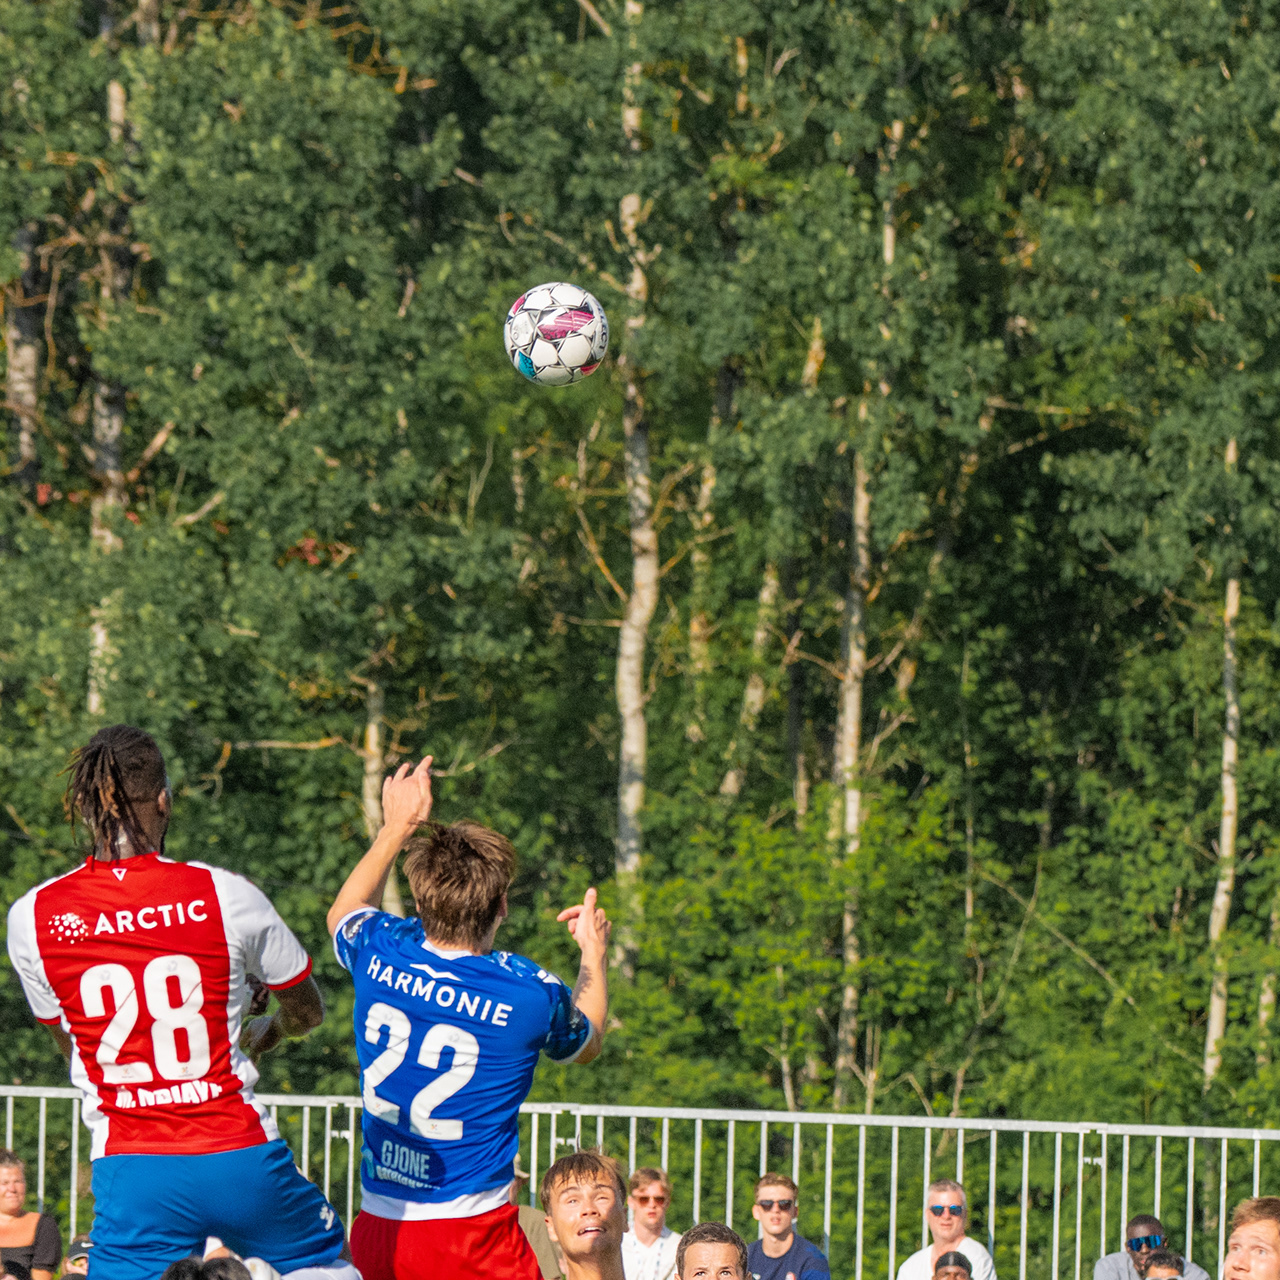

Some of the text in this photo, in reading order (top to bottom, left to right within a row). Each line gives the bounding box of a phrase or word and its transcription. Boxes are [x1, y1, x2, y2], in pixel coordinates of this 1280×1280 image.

[94, 900, 207, 935] ARCTIC
[79, 954, 211, 1084] 28
[367, 954, 513, 1027] HARMONIE
[364, 1002, 480, 1140] 22
[381, 1140, 430, 1180] GJONE
